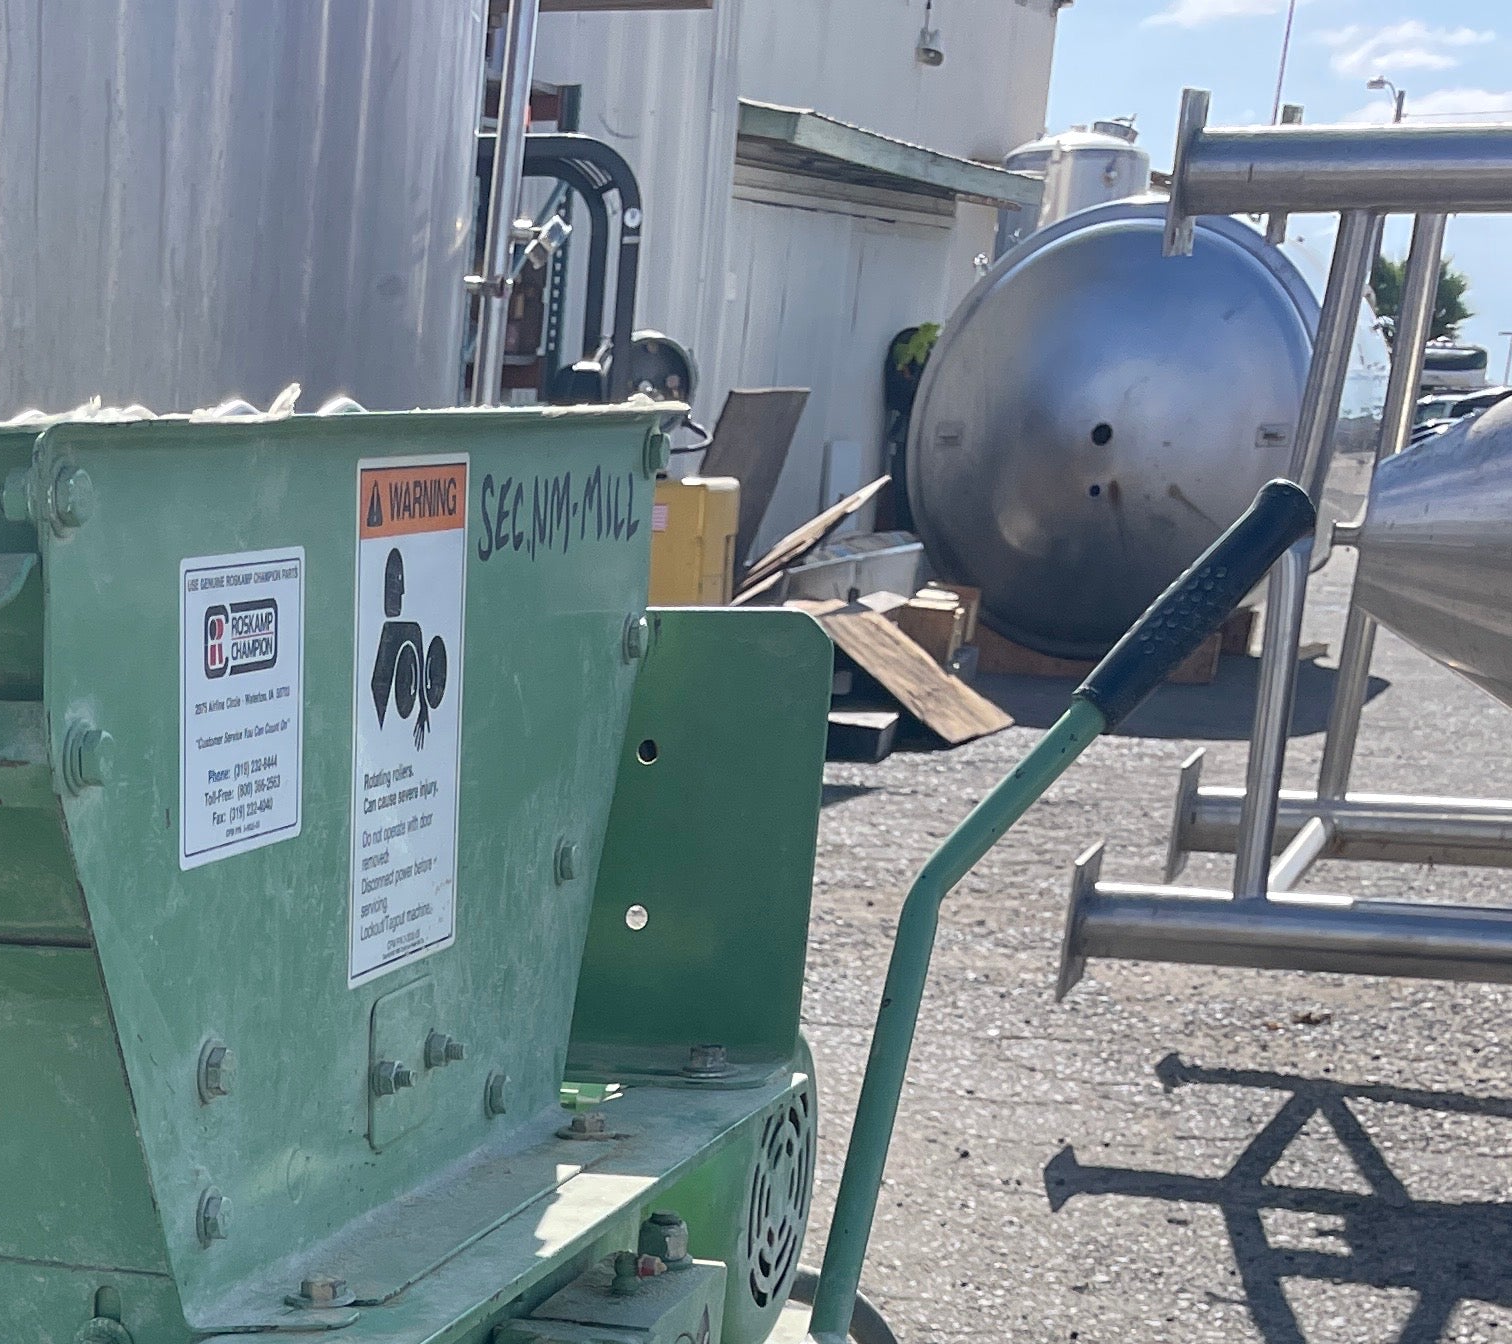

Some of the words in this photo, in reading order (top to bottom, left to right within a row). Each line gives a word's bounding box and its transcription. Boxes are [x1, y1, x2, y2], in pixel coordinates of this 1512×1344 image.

[389, 477, 457, 522] WARNING
[226, 573, 253, 587] ROSKAMP
[231, 612, 274, 636] ROSKAMP
[231, 637, 273, 661] CHAMPION
[208, 769, 231, 784] Phone:
[234, 761, 250, 781] (319)
[364, 768, 392, 791] Rotating
[204, 788, 234, 807] Toll-Free:
[363, 797, 377, 815] Can
[377, 793, 397, 811] cause
[398, 786, 419, 804] severe
[419, 778, 439, 800] injury.
[212, 811, 226, 826] Fax:
[229, 803, 246, 824] (319)
[362, 830, 372, 849] Do
[372, 827, 383, 844] not
[383, 819, 406, 845] operate
[407, 814, 419, 833] with
[419, 812, 434, 829] door
[361, 868, 395, 895] Disconnect
[395, 864, 414, 887] power
